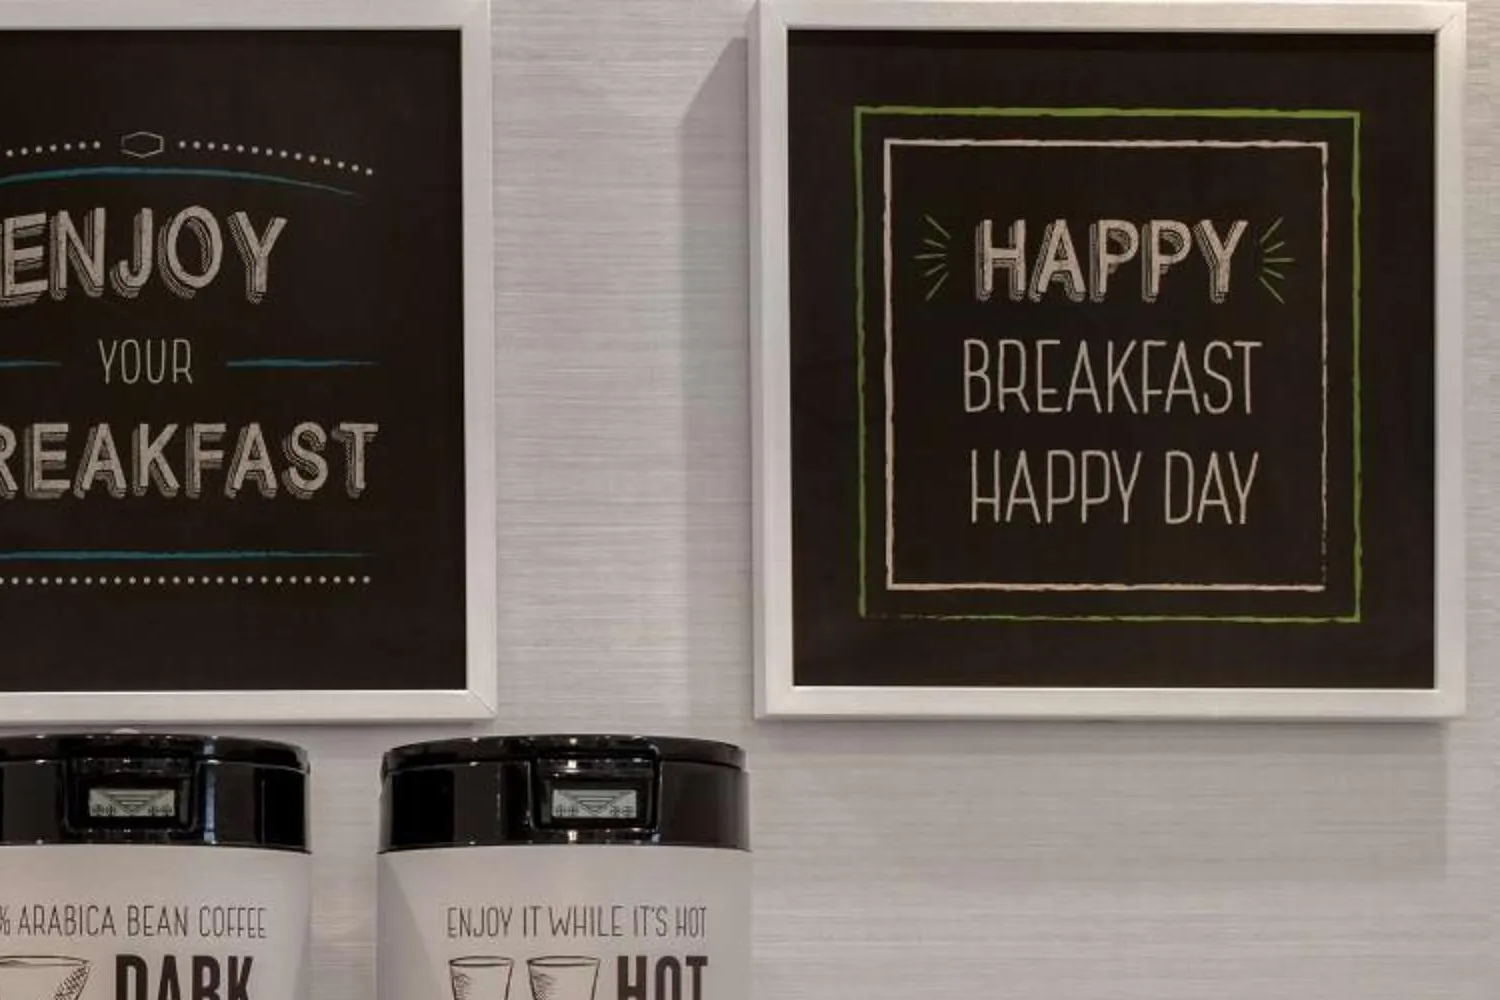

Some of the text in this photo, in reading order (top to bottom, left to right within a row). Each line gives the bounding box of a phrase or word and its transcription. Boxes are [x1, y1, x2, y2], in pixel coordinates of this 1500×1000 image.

[975, 219, 1248, 303] HAPPY
[98, 338, 193, 385] YOUR
[963, 339, 1263, 415] BREAKFAST
[971, 449, 1259, 526] HAPPY DAY
[17, 904, 117, 938] ARABICA
[127, 905, 189, 938] BEAN
[199, 906, 268, 939] COFFEE
[447, 904, 708, 938] ENJOY IT WHILE IT'S HOT
